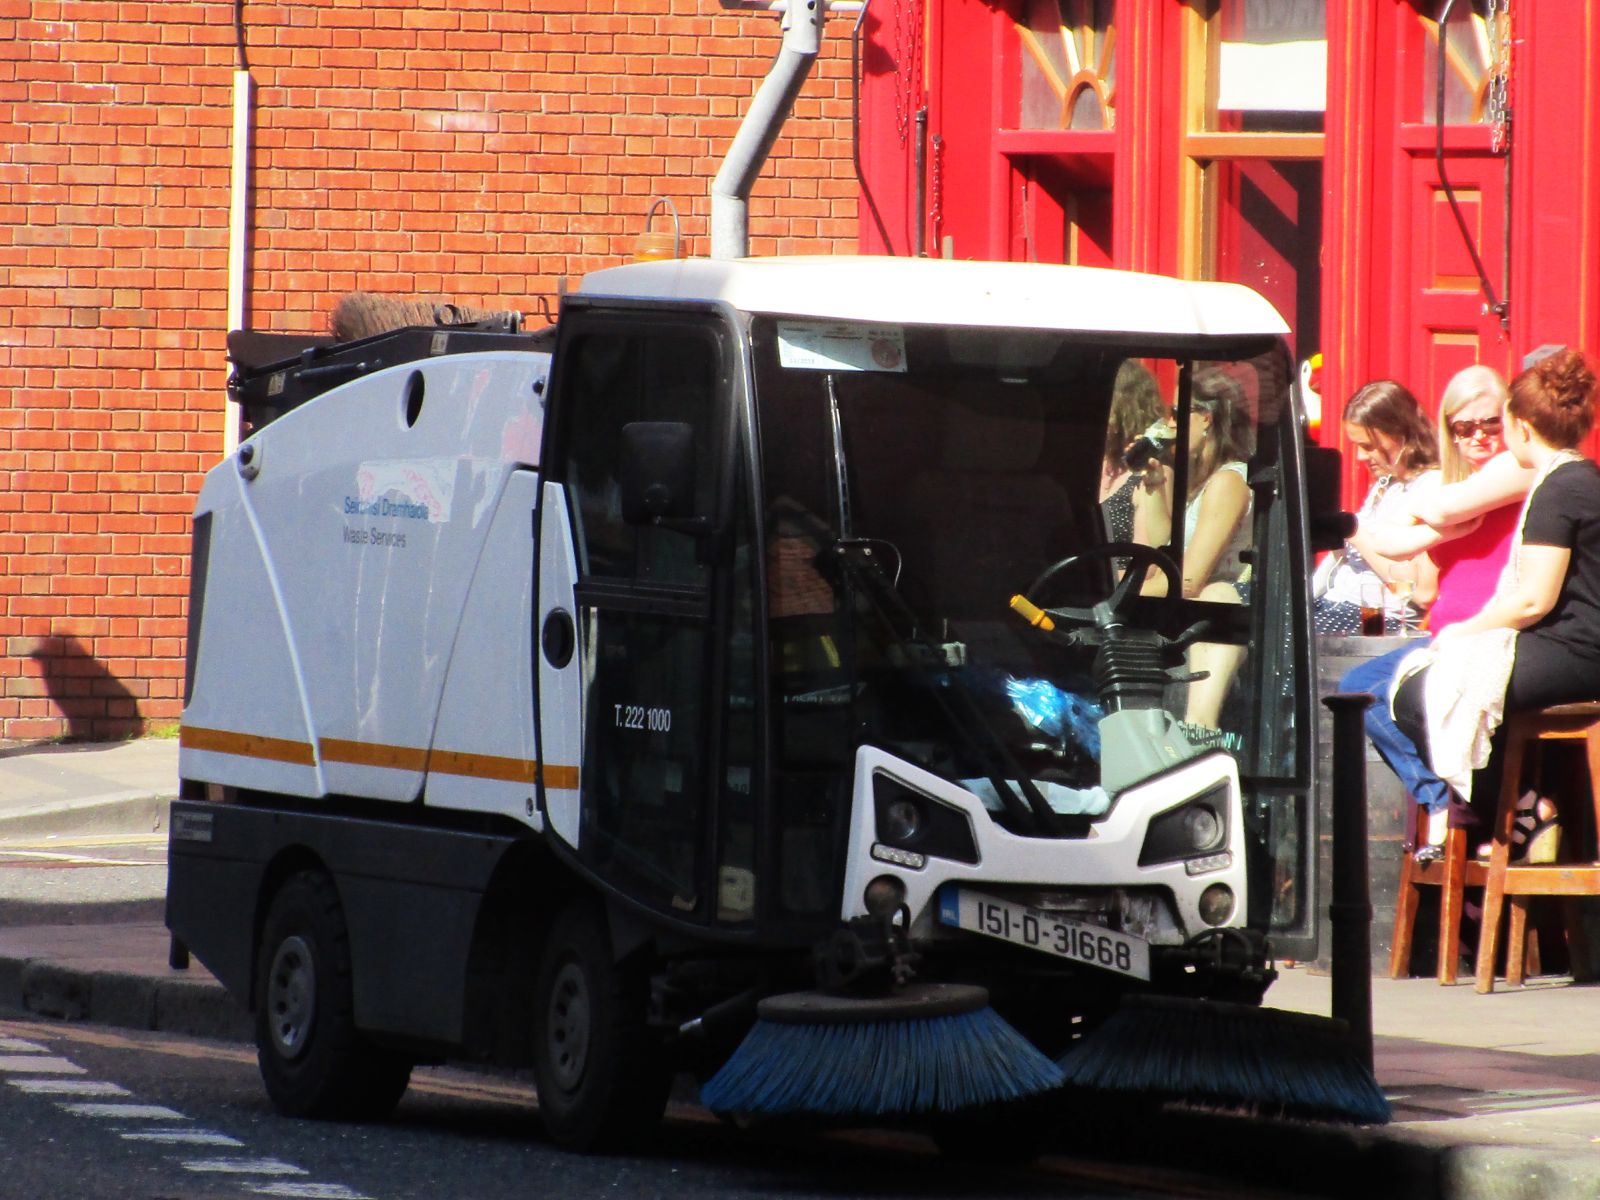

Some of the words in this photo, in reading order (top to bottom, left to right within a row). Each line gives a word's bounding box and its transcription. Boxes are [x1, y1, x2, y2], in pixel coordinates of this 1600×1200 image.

[343, 526, 368, 544] Waste
[370, 527, 406, 548] Services
[614, 704, 622, 727] T.
[625, 706, 644, 729] 222
[647, 708, 671, 732] 1000
[978, 902, 1131, 971] 151-D-31668
